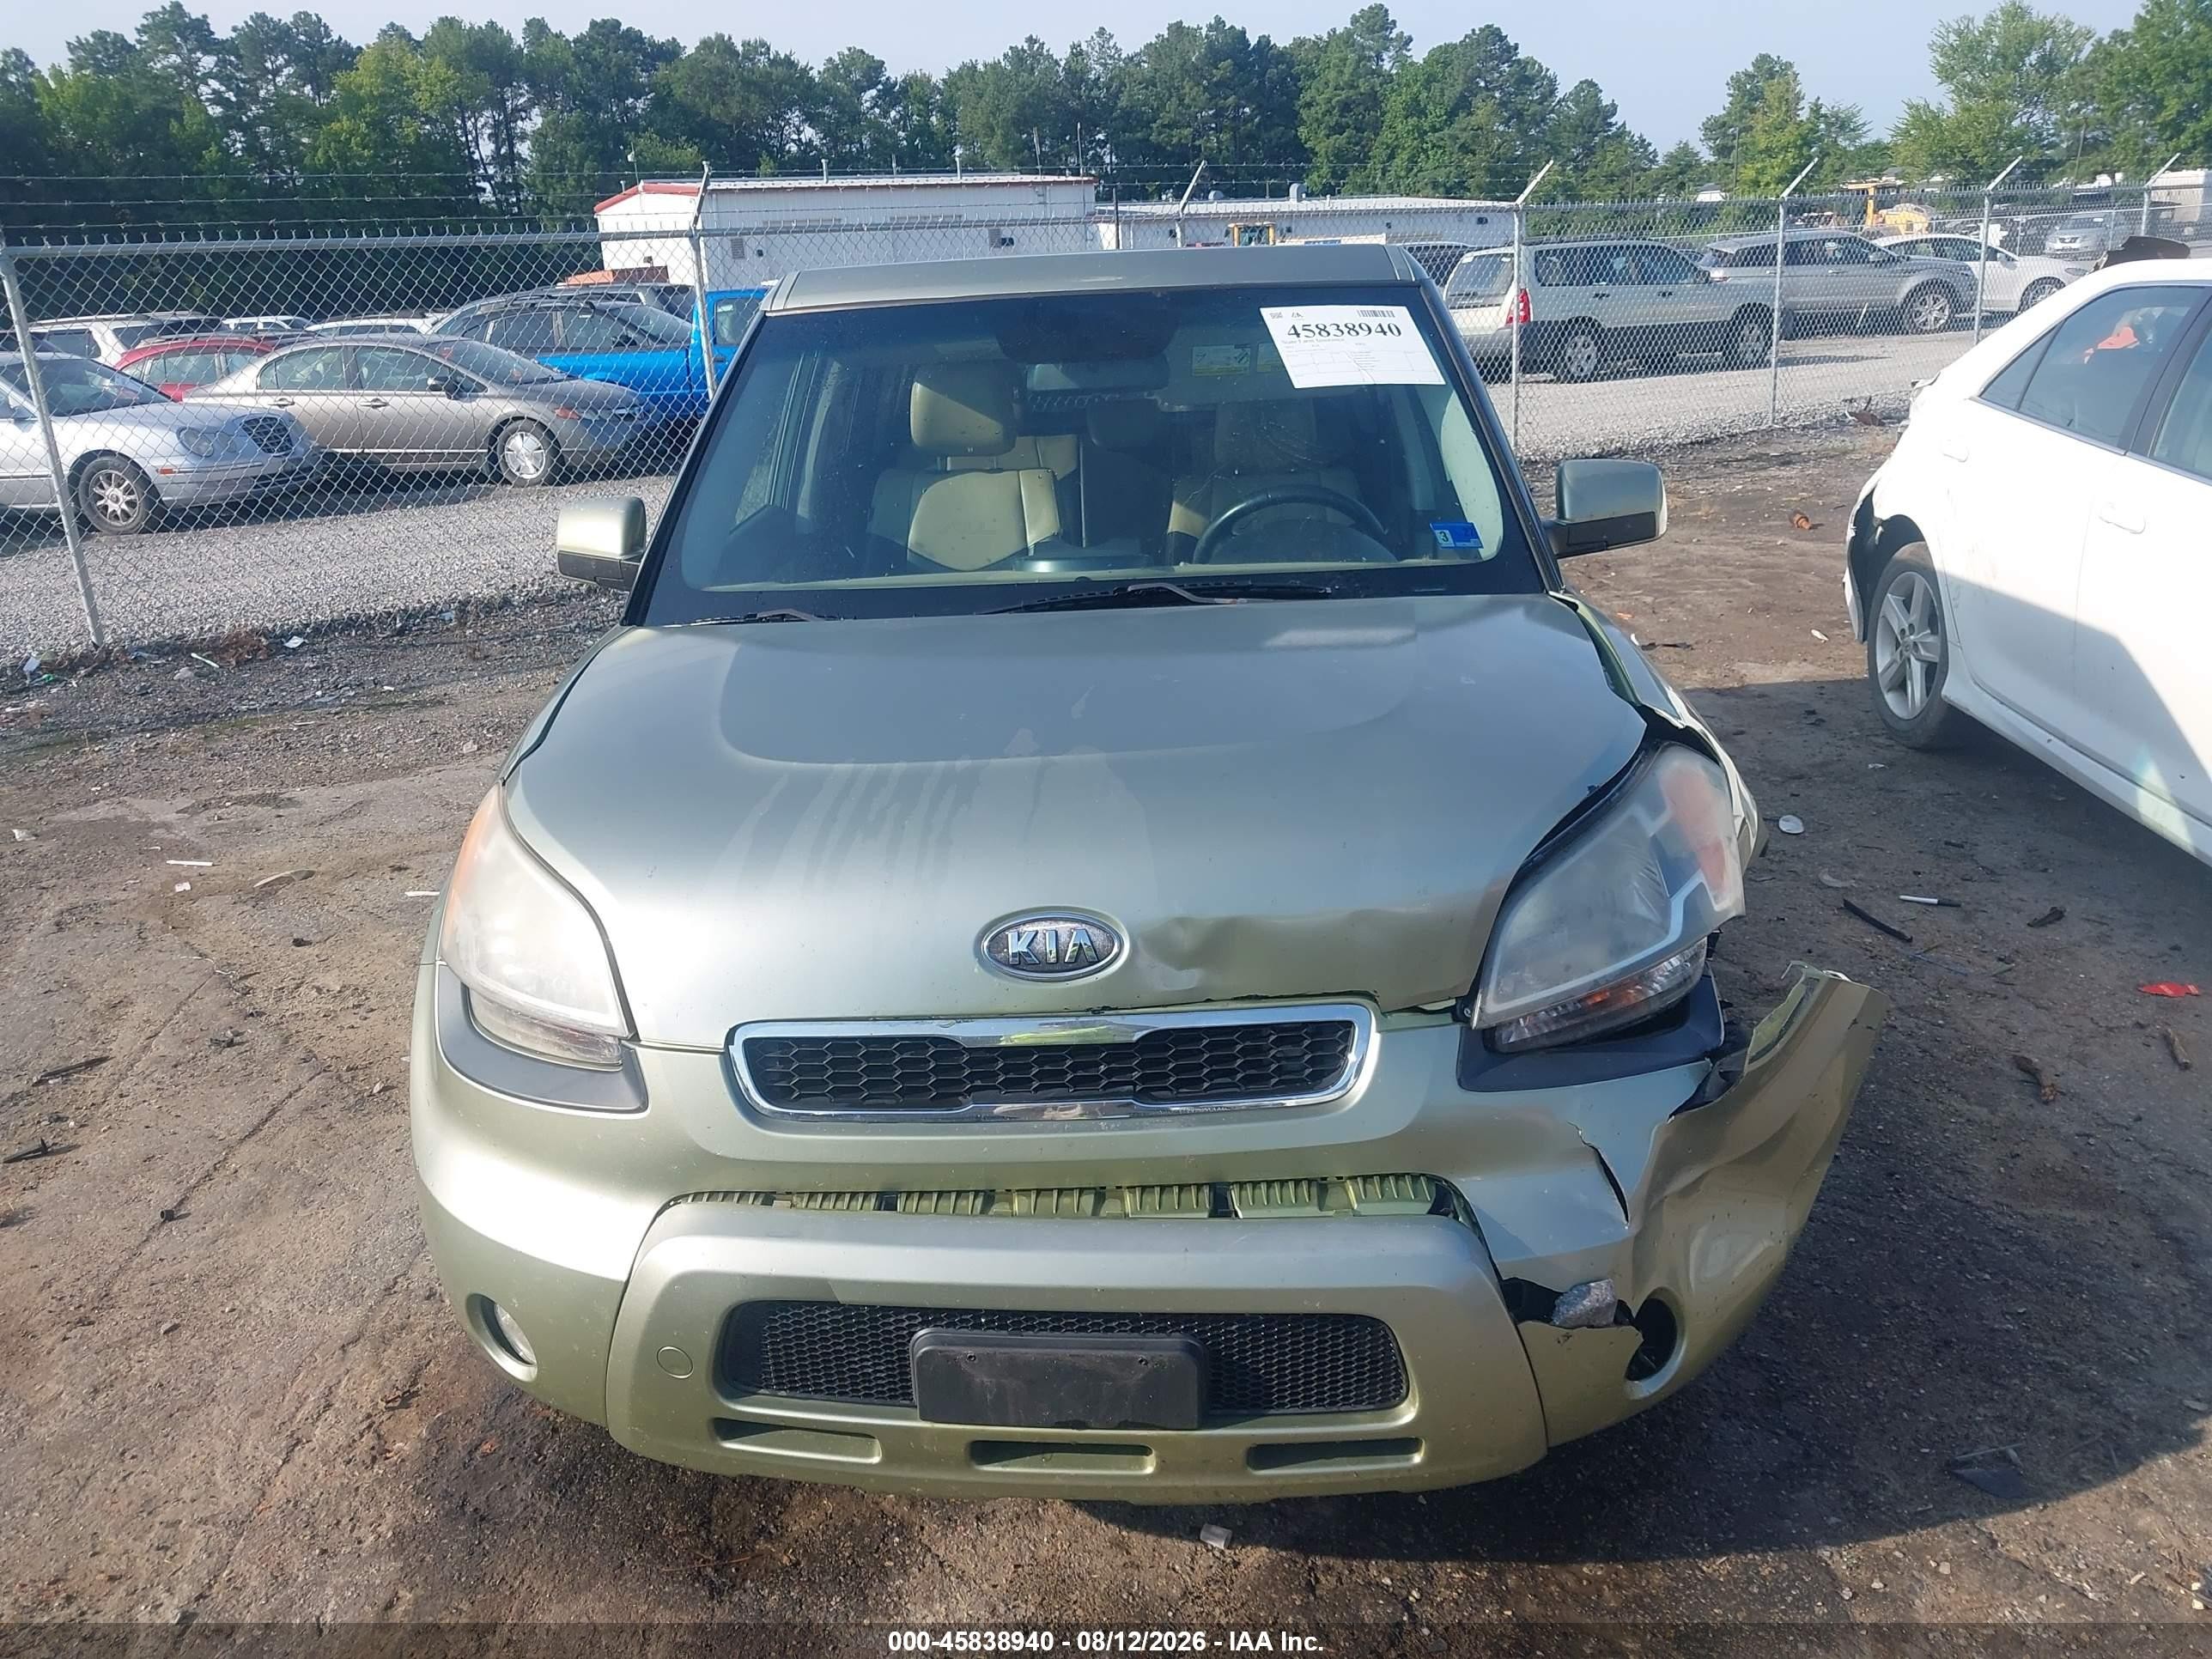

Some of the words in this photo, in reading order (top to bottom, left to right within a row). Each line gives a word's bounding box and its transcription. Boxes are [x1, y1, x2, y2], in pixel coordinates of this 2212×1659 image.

[1287, 322, 1401, 338] 45838940
[1439, 531, 1449, 543] 3
[1007, 929, 1099, 965] KIA
